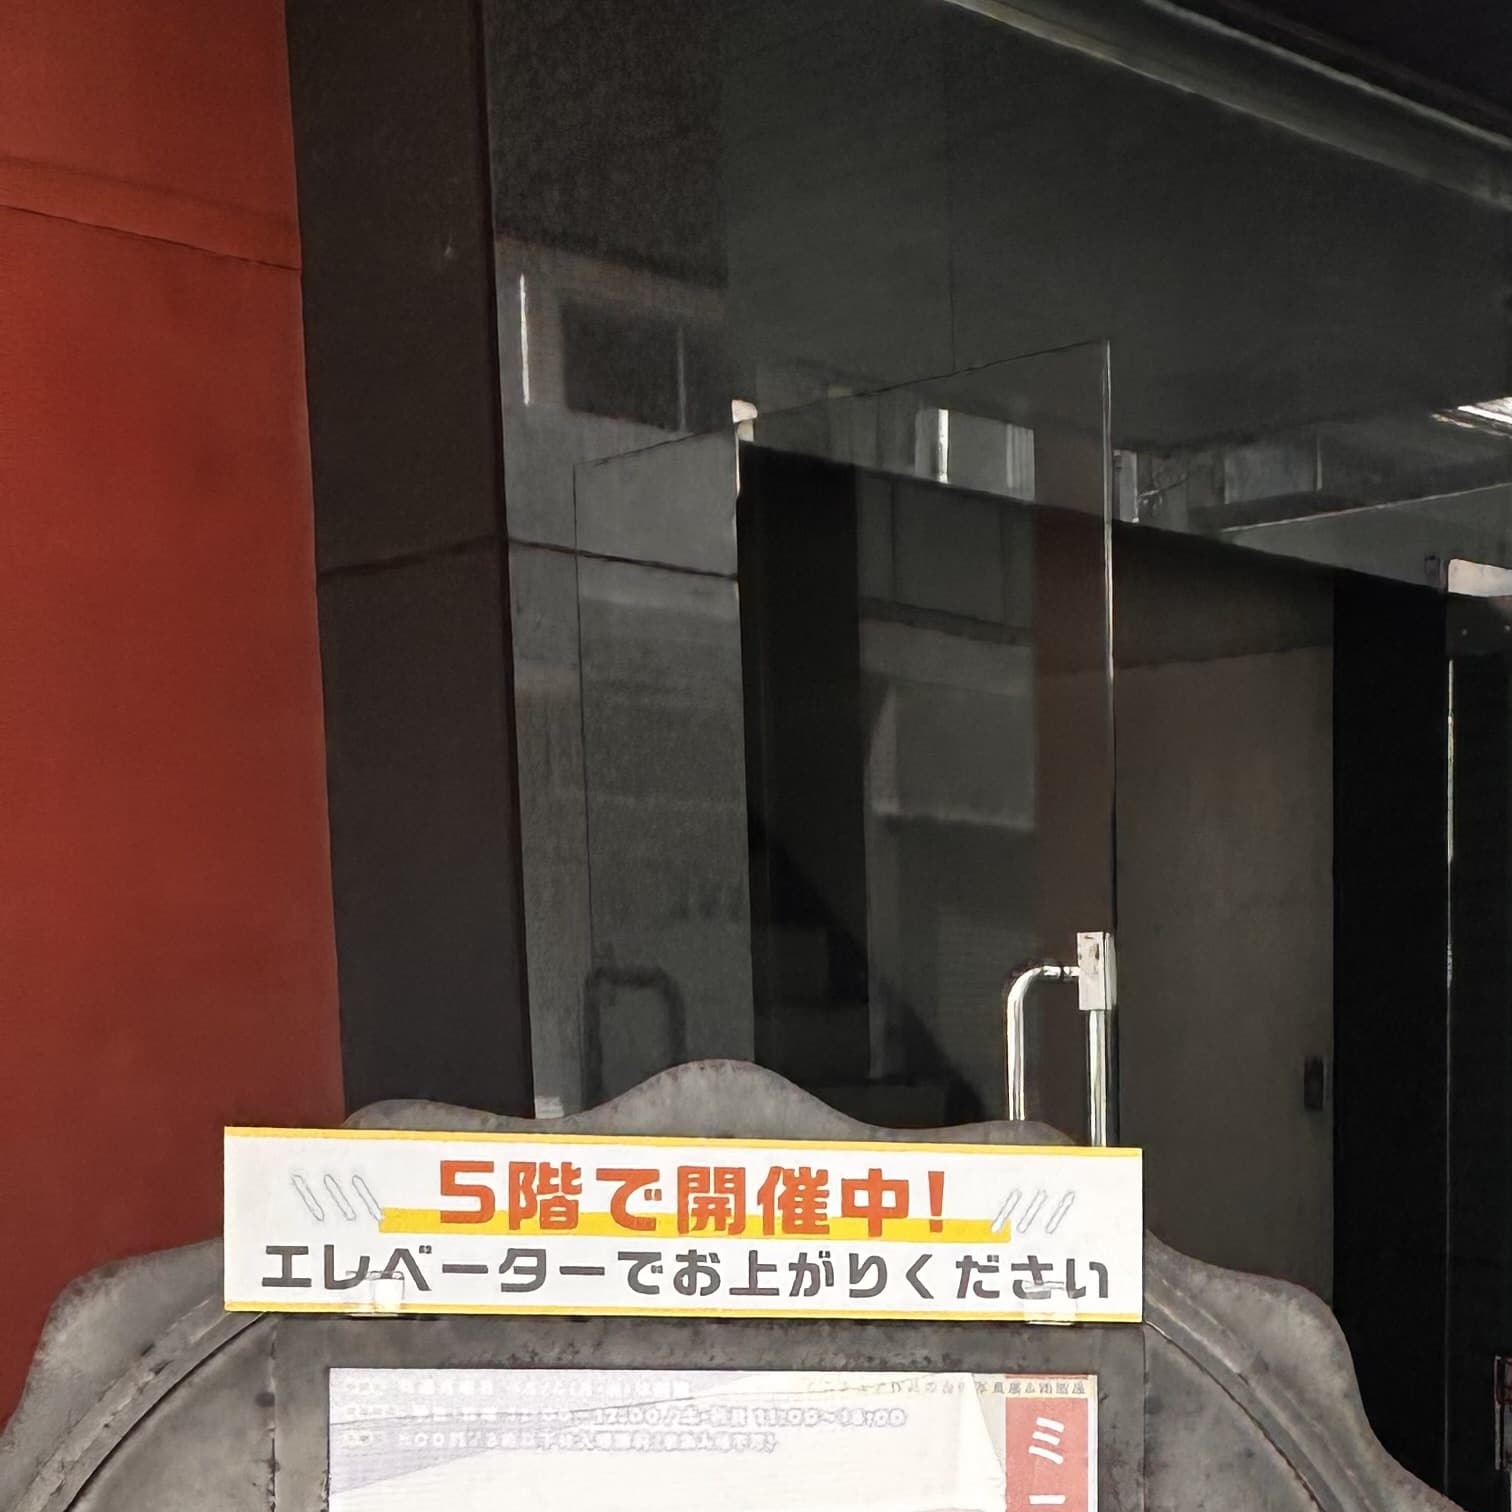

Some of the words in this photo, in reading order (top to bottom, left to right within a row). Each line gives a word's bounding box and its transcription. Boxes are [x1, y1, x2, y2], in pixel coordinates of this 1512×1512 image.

[438, 1159, 946, 1236] 5階で開催中!
[261, 1244, 1110, 1300] エレベーターでお上がりください
